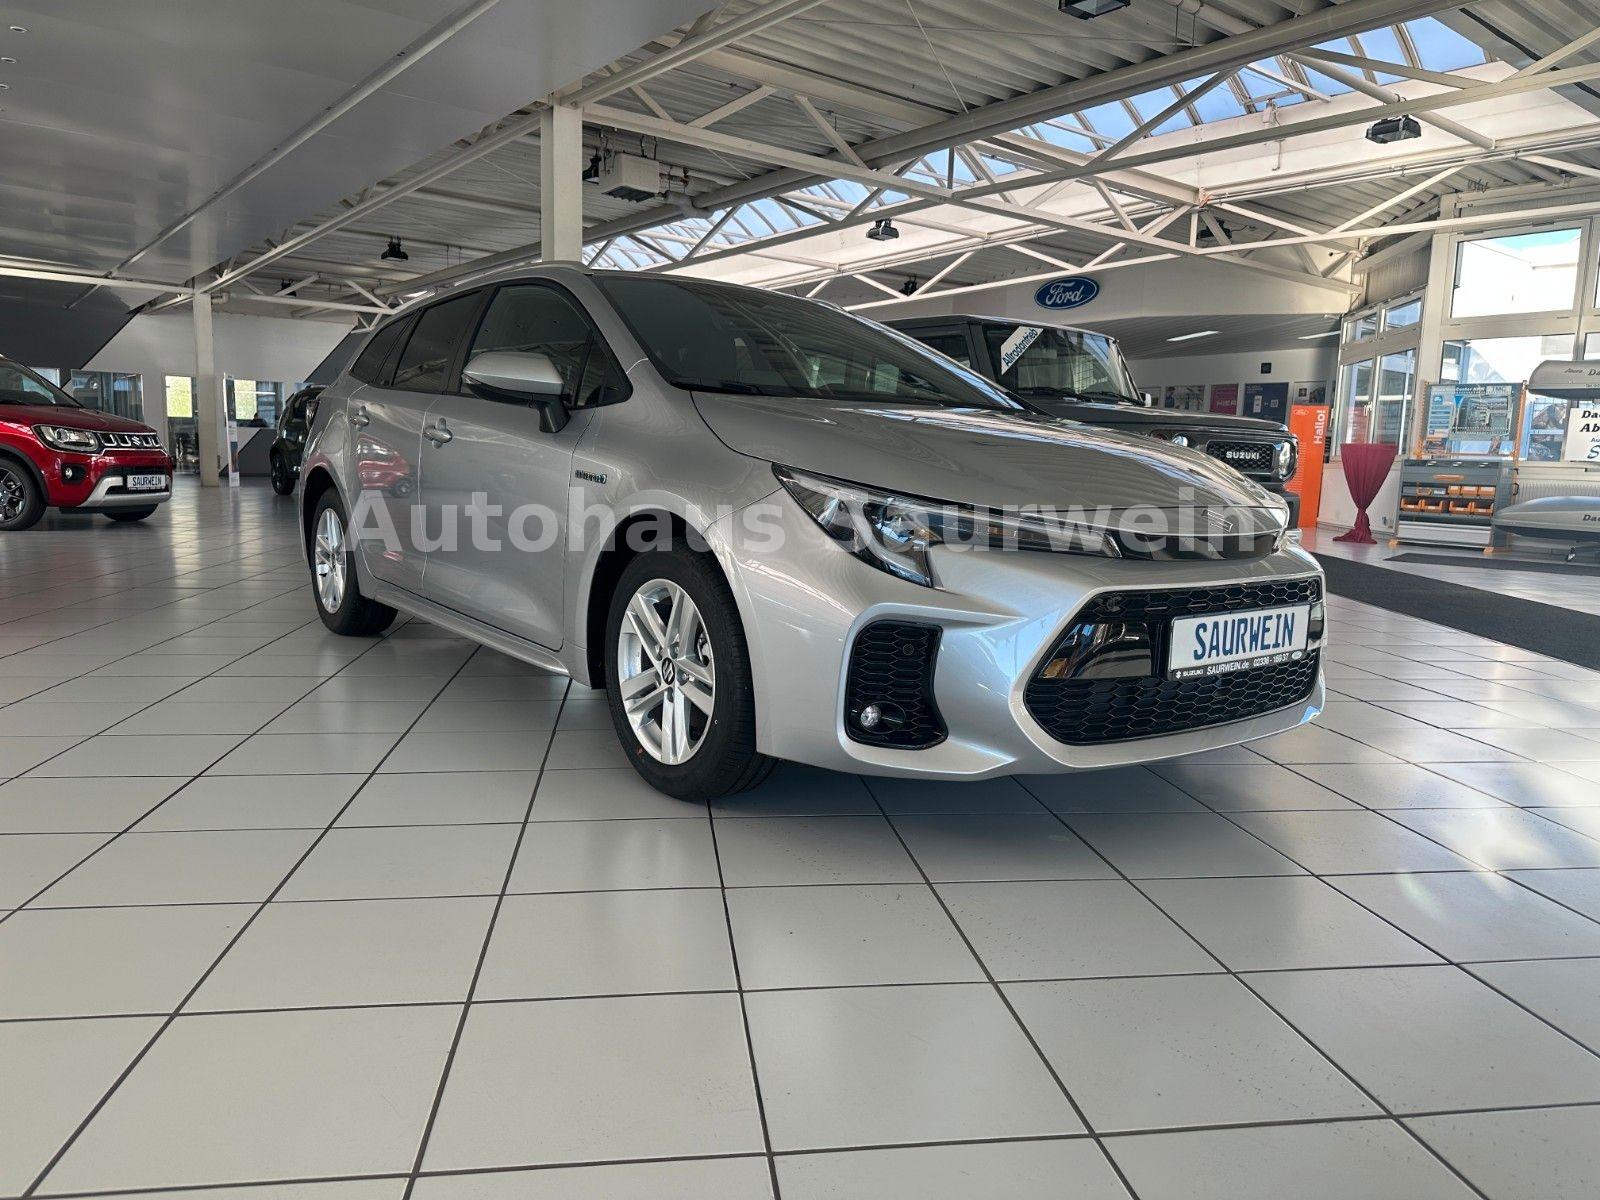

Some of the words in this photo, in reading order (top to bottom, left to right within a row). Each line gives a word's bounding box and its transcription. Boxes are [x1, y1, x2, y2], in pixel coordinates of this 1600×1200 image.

[1045, 281, 1084, 305] Ford
[1002, 327, 1038, 367] Allradantrieb
[1313, 409, 1326, 445] Hallo!
[1226, 451, 1260, 460] SUZUKI
[132, 476, 162, 487] SAURWEIN
[1193, 612, 1295, 661] SAURWEIN
[1206, 660, 1250, 675] SAURWEIN.de
